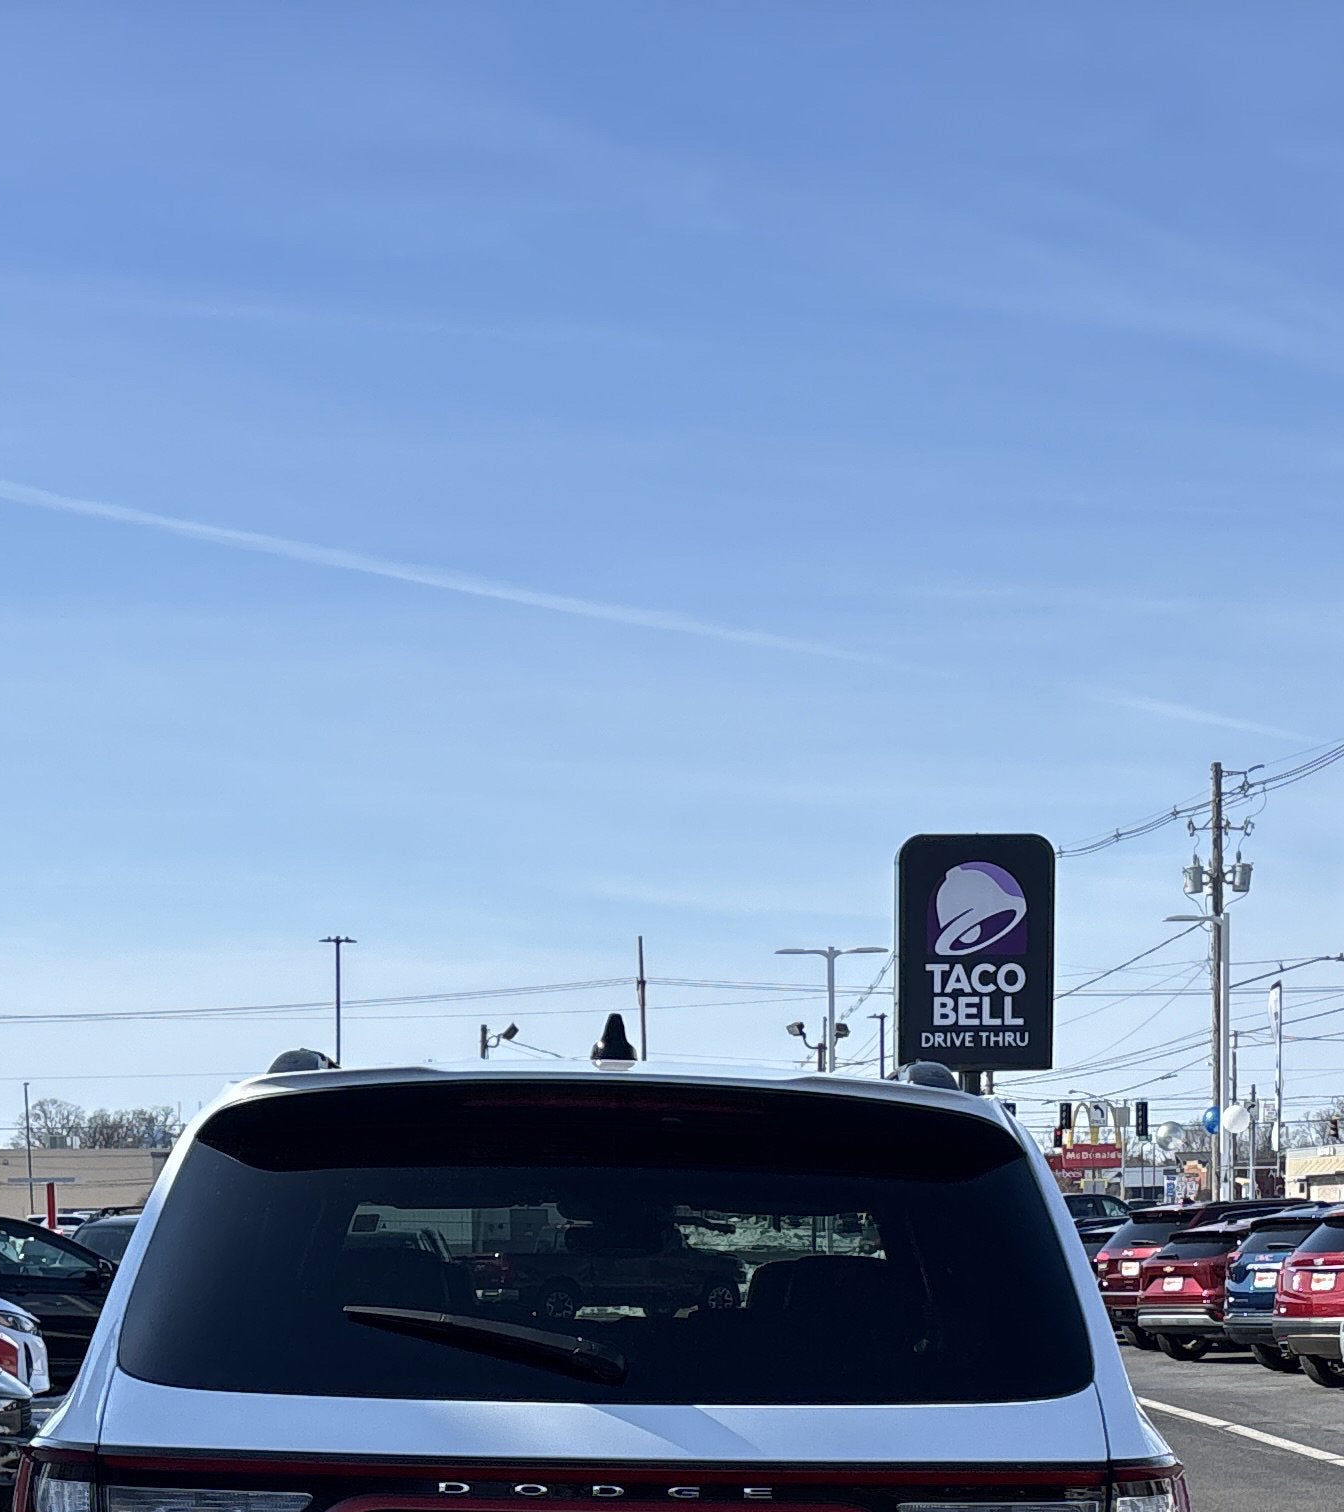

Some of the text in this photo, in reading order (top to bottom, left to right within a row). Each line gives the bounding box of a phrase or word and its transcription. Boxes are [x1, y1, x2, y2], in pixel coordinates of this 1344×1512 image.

[925, 962, 1027, 993] TACO
[933, 996, 1025, 1026] BELL
[921, 1032, 1029, 1048] DRIVE THRU
[438, 1481, 773, 1500] DODGE
